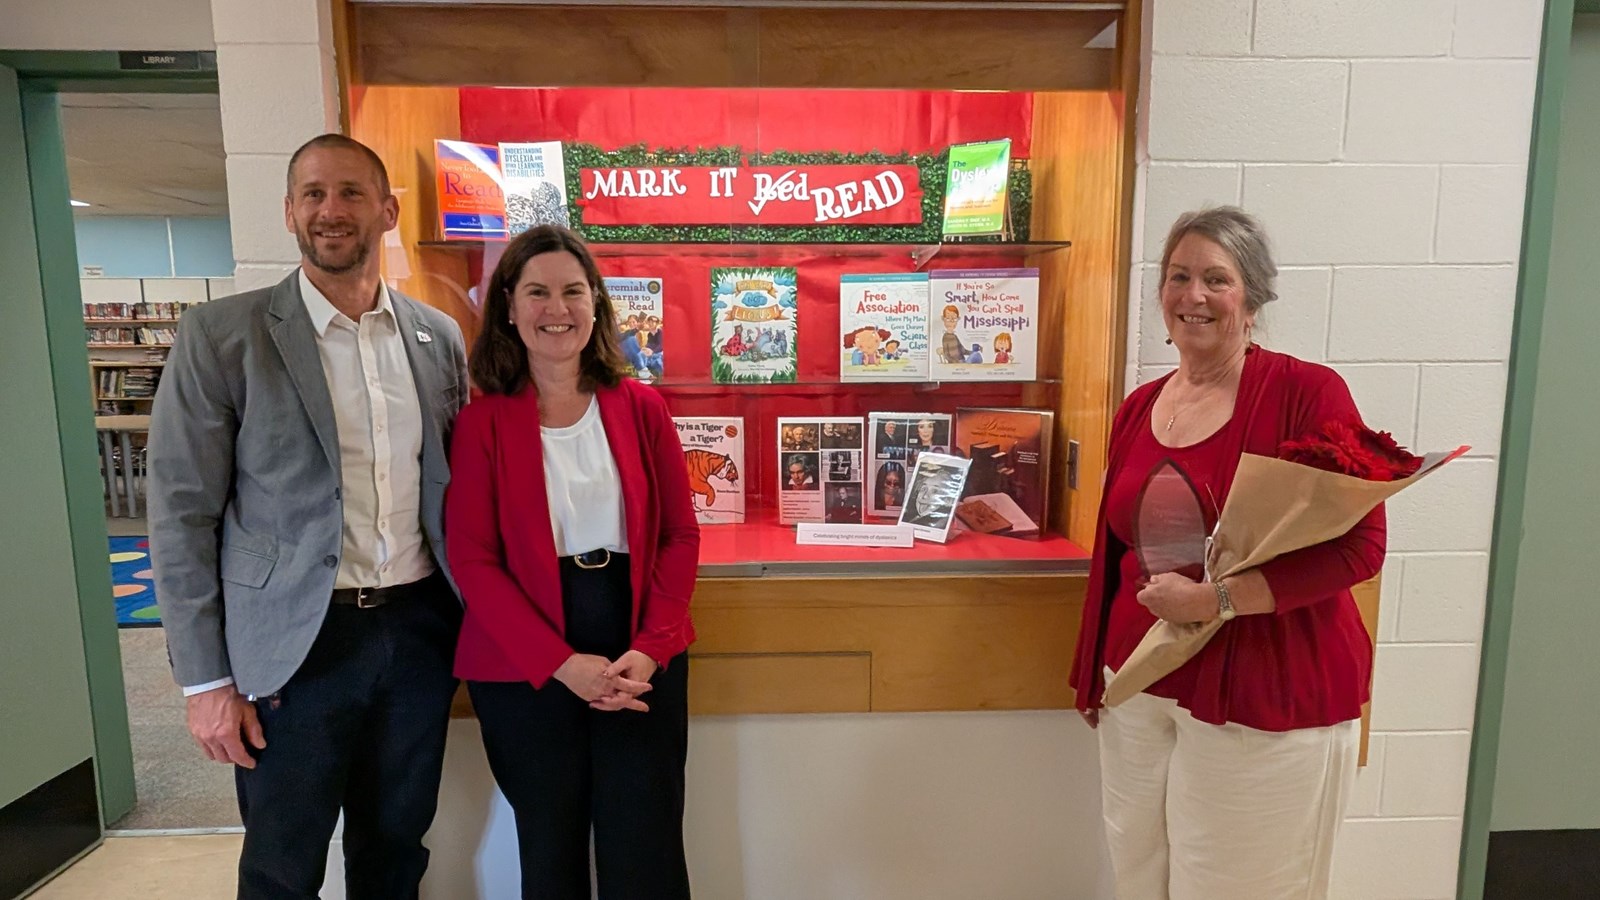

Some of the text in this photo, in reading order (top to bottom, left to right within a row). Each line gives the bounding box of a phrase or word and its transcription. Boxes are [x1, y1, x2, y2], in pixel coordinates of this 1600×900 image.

[505, 154, 534, 162] DYSLEXIA
[506, 169, 545, 177] DISABILITIES
[444, 171, 504, 198] Read
[586, 168, 687, 200] MARK
[709, 167, 737, 197] IT
[810, 170, 905, 222] READ
[606, 281, 646, 291] eremiah
[964, 281, 983, 290] You're
[985, 282, 995, 290] So
[864, 290, 887, 302] Free
[945, 291, 980, 304] Smart,
[1000, 293, 1020, 301] Come
[628, 300, 655, 311] Read
[856, 301, 920, 314] Association
[967, 303, 1024, 314] You Can't Spell
[903, 316, 912, 324] My
[964, 315, 1030, 331] Mississippi
[900, 331, 928, 341] Scienc
[909, 341, 928, 350] Class
[675, 422, 685, 431] hy
[701, 422, 724, 432] Tiger
[696, 434, 724, 444] Tiger?
